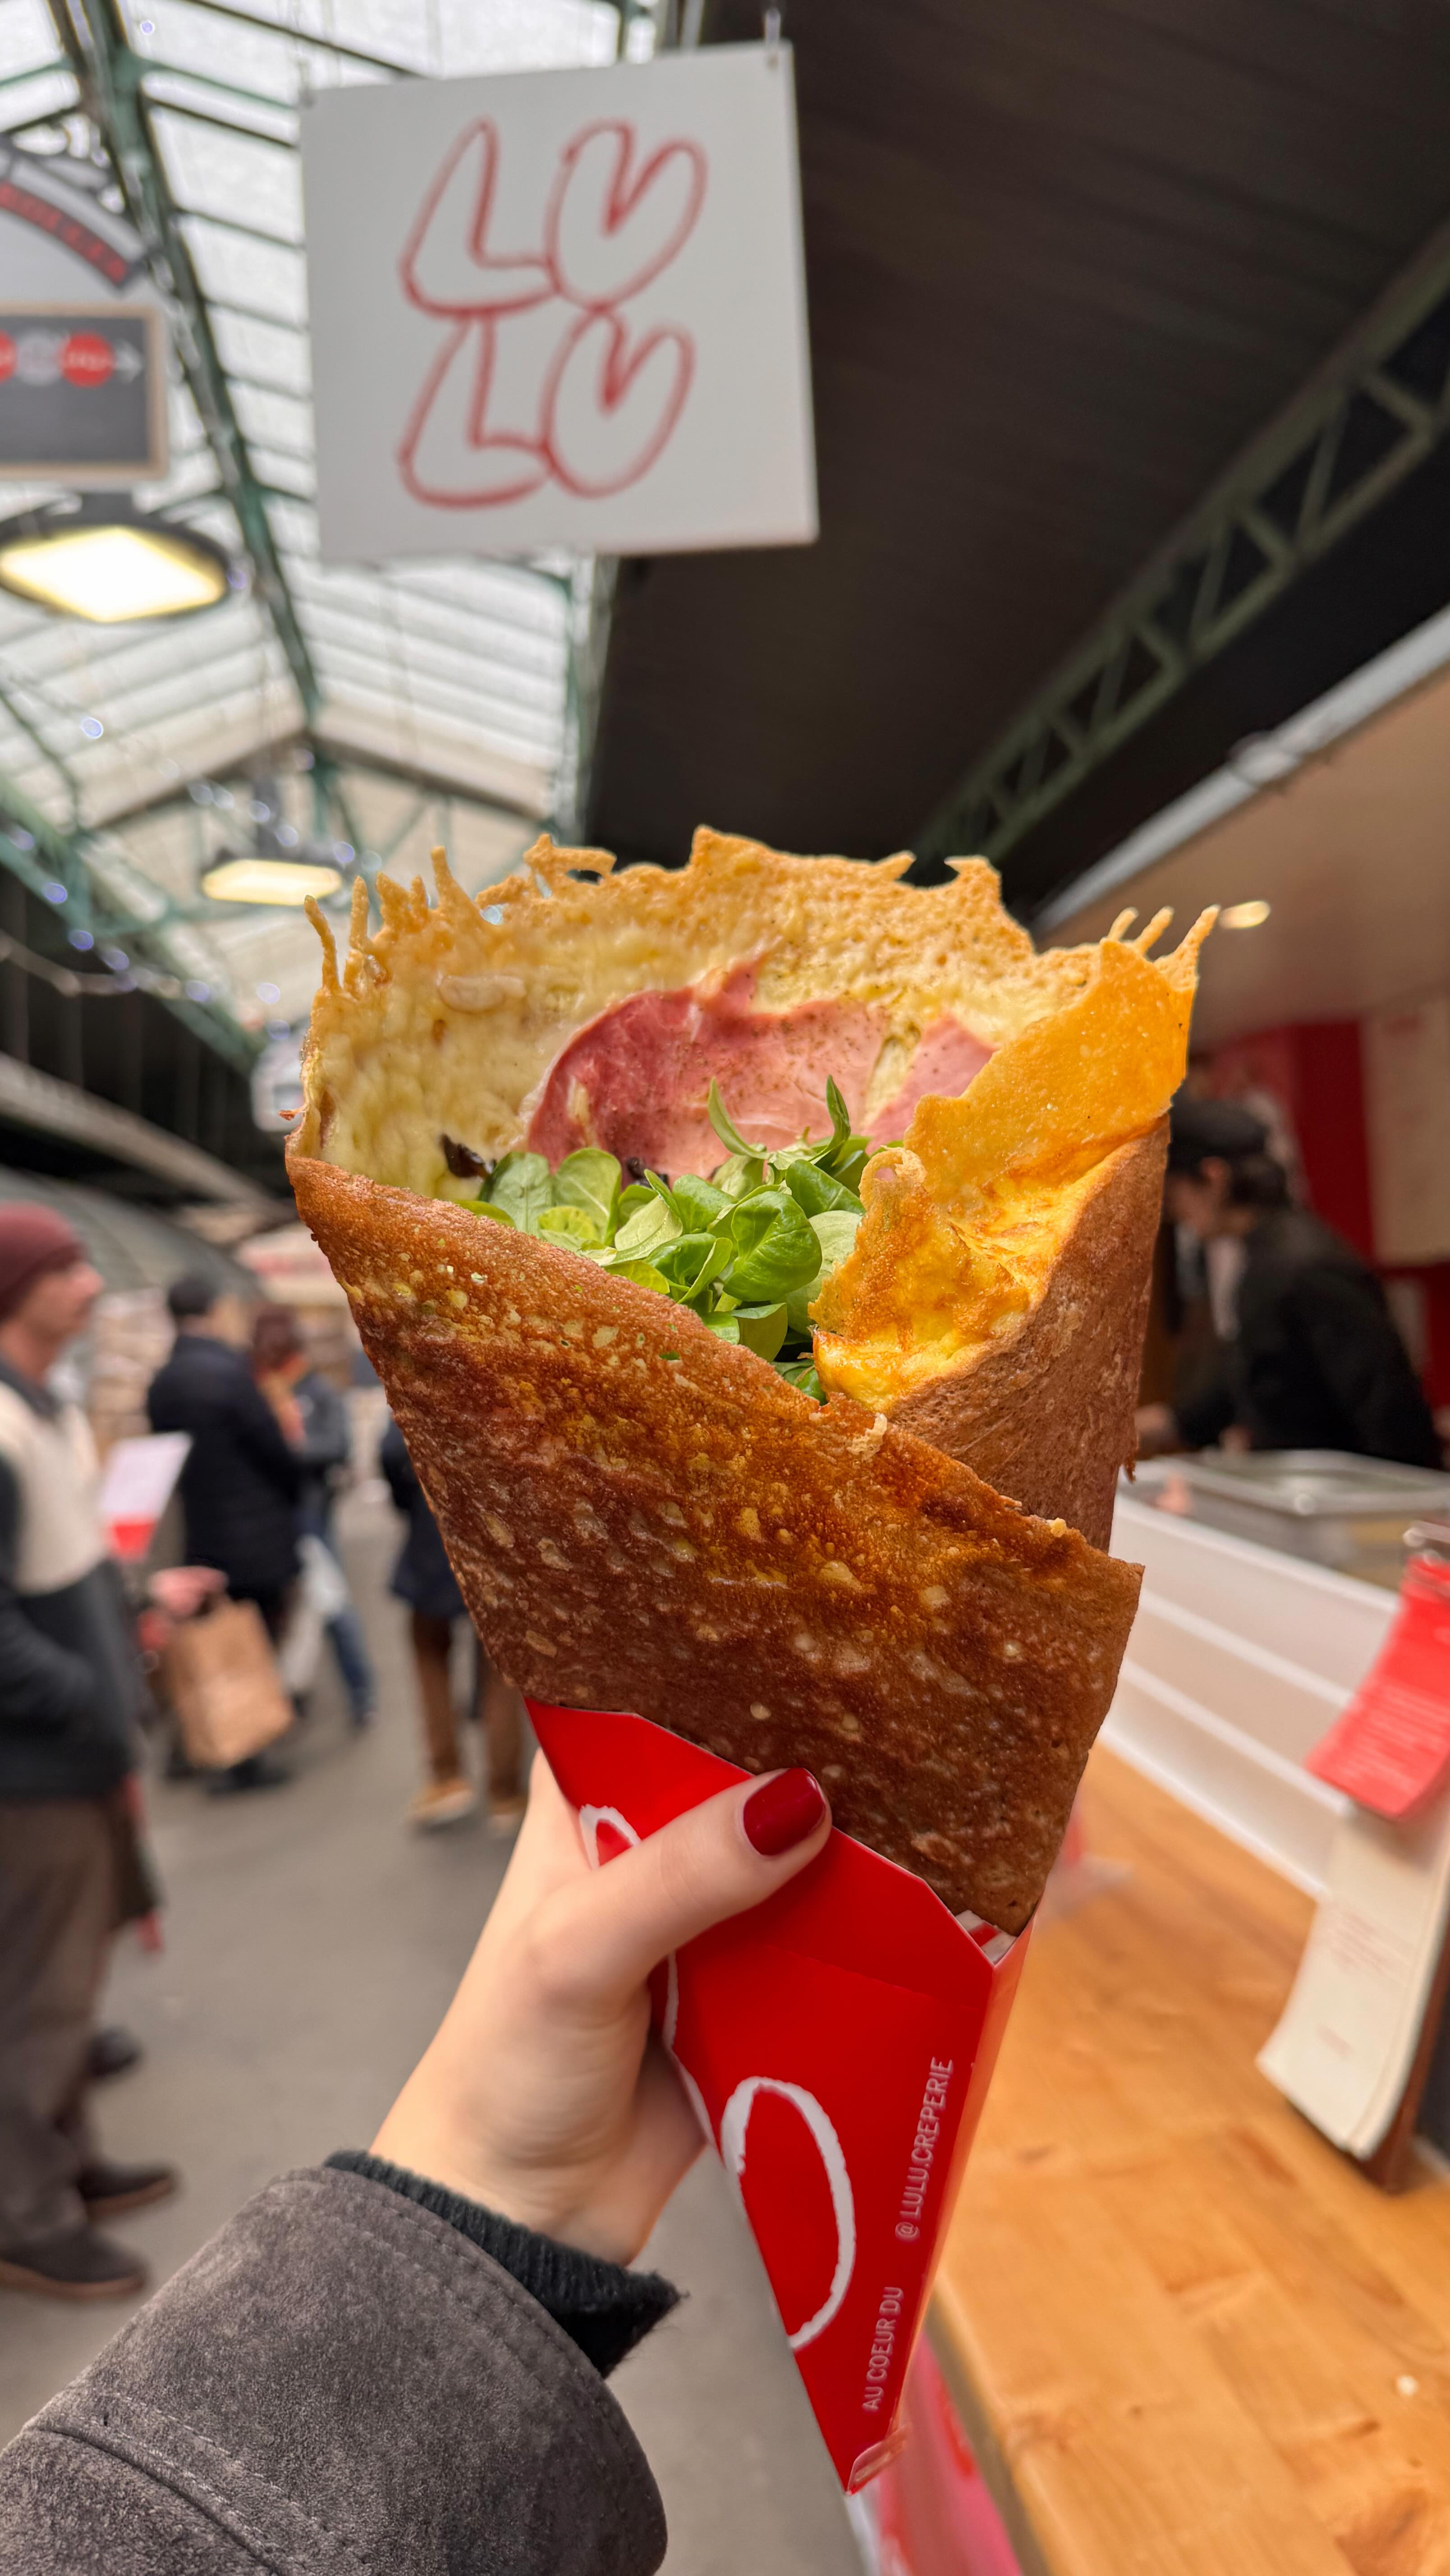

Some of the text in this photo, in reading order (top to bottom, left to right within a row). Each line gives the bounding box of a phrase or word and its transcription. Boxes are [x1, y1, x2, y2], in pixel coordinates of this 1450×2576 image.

[862, 2286, 904, 2412] AU COEUR DU
